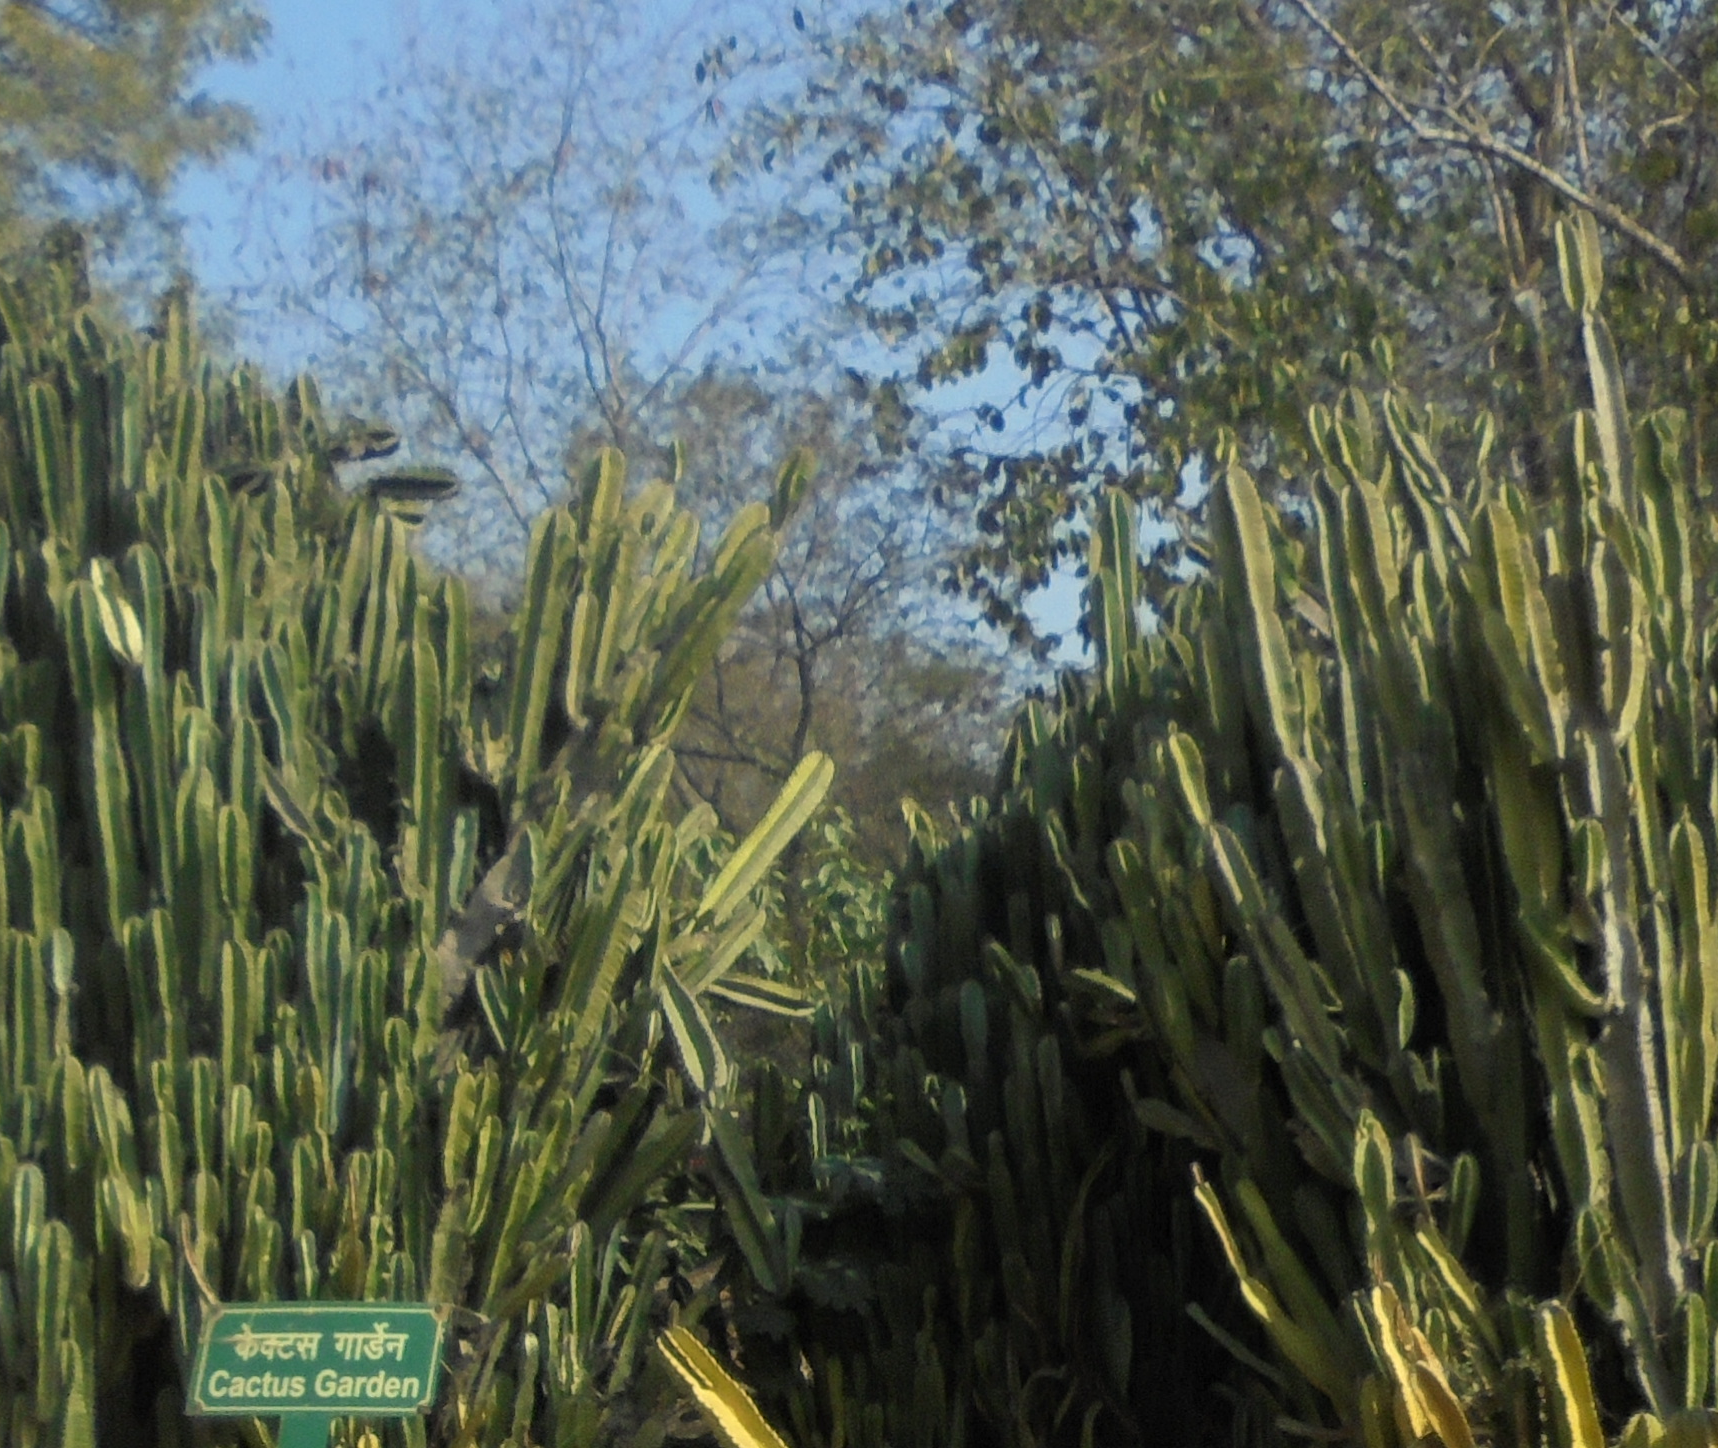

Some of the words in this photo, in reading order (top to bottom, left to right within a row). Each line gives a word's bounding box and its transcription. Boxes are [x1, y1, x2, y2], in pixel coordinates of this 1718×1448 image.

[333, 1321, 409, 1361] गार्डेन
[208, 1370, 305, 1398] Cactus
[314, 1369, 419, 1398] Garden
